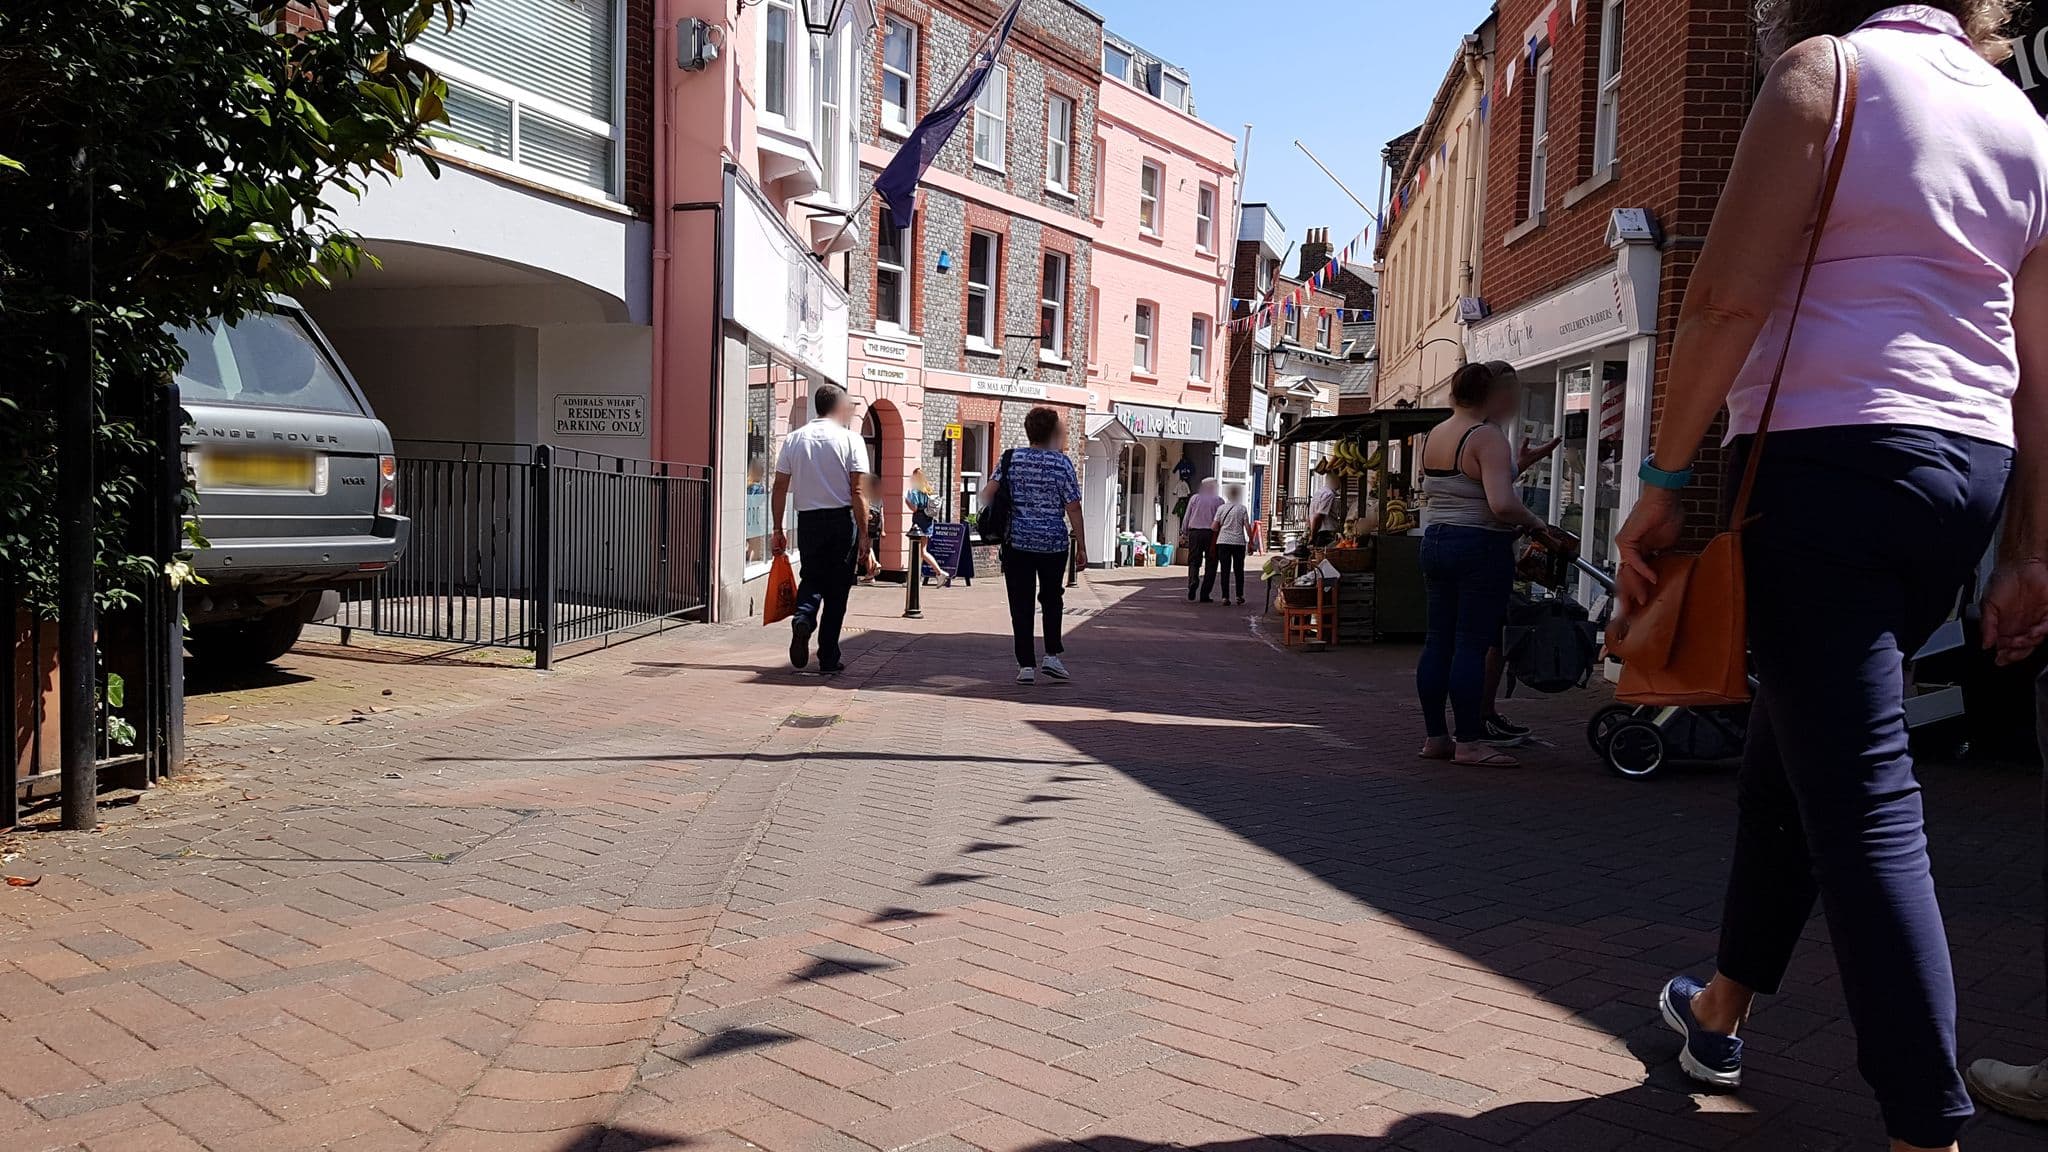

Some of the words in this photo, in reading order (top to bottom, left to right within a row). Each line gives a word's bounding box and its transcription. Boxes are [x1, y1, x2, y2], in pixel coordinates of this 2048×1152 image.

[1559, 316, 1590, 336] GENTLEMEN'S
[1590, 308, 1612, 325] BARBERS
[867, 343, 879, 352] THE
[879, 345, 905, 355] PROSPECT
[867, 367, 876, 376] THE
[976, 380, 986, 390] SIR
[987, 382, 999, 391] MAX
[1019, 386, 1041, 395] MUSEUM
[563, 398, 604, 407] ADMIRALS
[606, 399, 637, 407] WHARF
[568, 408, 631, 420] RESIDENTS
[557, 420, 606, 432] PARKING
[611, 420, 642, 432] ONLY
[180, 426, 257, 440] RANGE
[272, 431, 339, 444] ROVER
